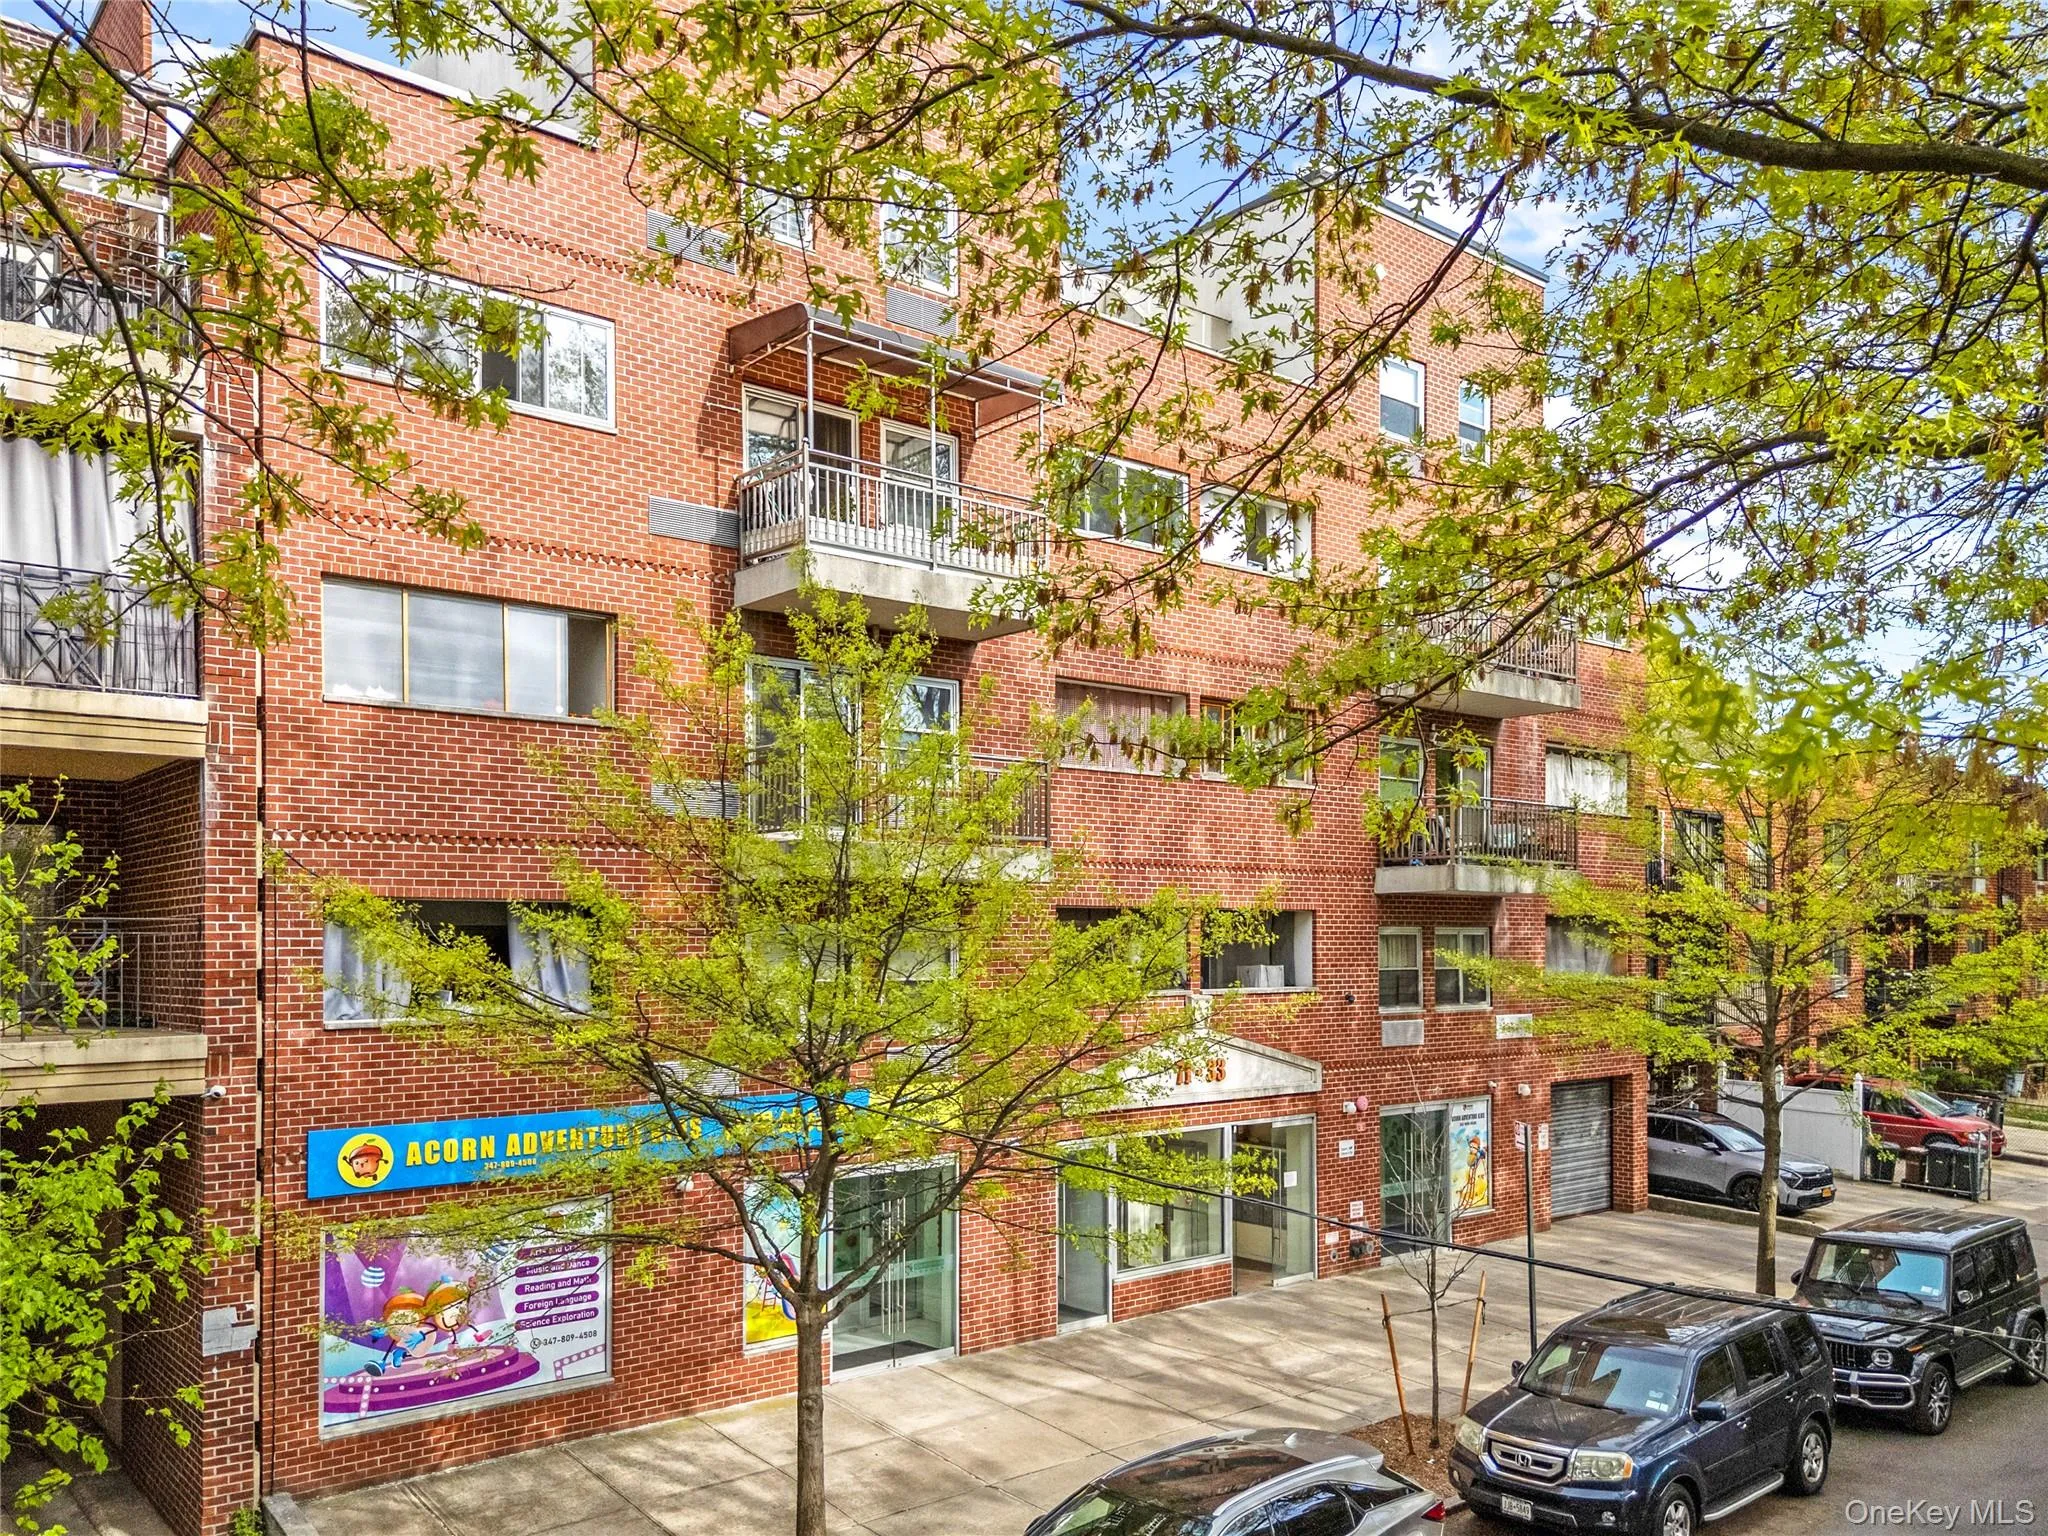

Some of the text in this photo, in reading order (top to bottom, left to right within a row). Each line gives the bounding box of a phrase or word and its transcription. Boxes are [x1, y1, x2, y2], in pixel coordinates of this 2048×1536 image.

[406, 1135, 495, 1167] ACORN
[524, 1281, 556, 1293] Reading
[557, 1278, 572, 1287] and
[524, 1299, 554, 1311] Foreign
[552, 1310, 595, 1323] Exploration
[543, 1330, 598, 1346] 347-809-4508
